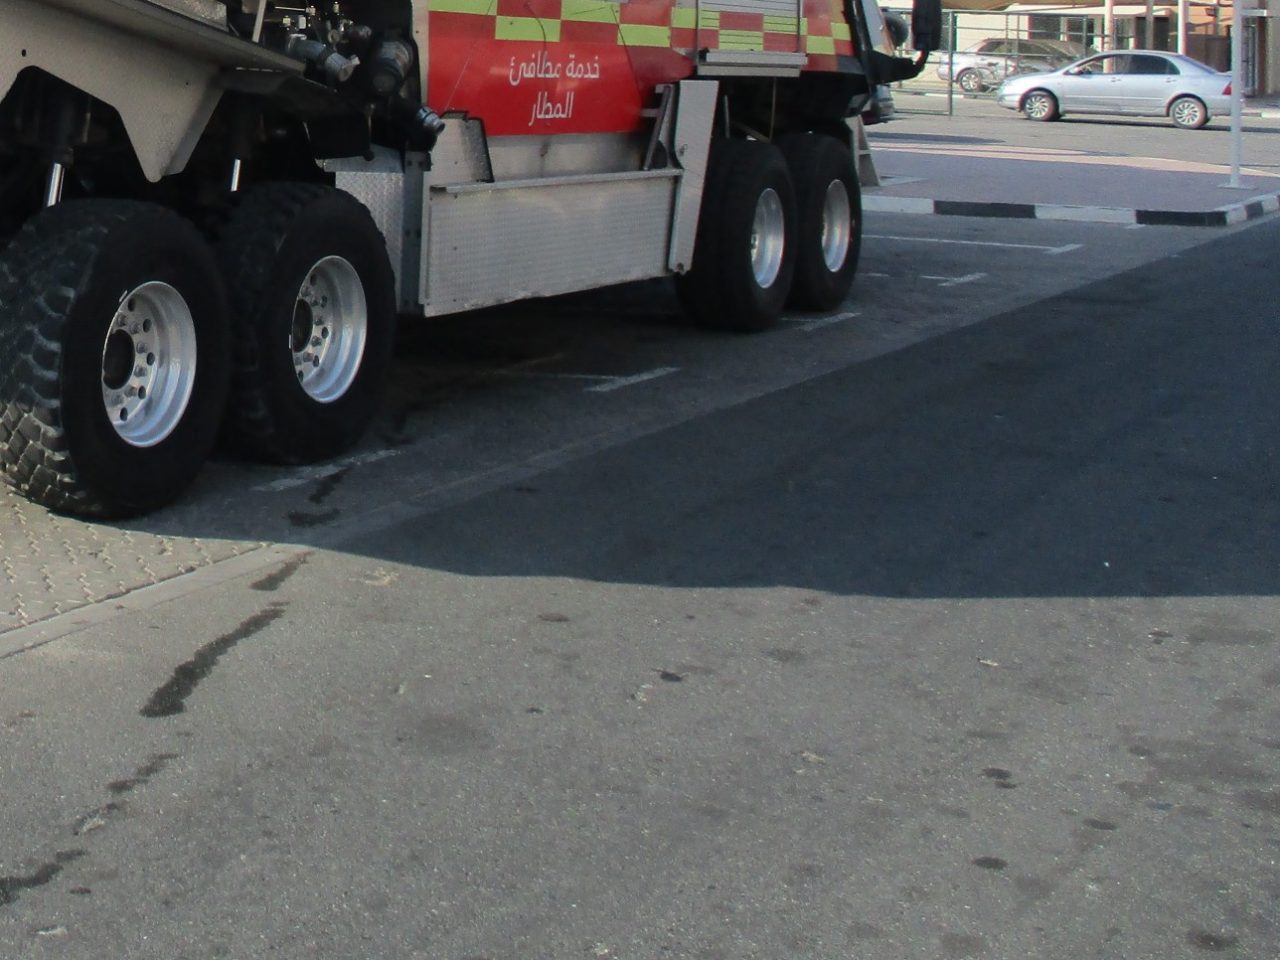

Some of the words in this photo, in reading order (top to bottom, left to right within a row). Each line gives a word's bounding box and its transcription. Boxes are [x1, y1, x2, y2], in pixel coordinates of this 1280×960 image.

[509, 50, 562, 86] مطافئ
[566, 54, 600, 79] خدمة
[528, 91, 575, 127] المطار
